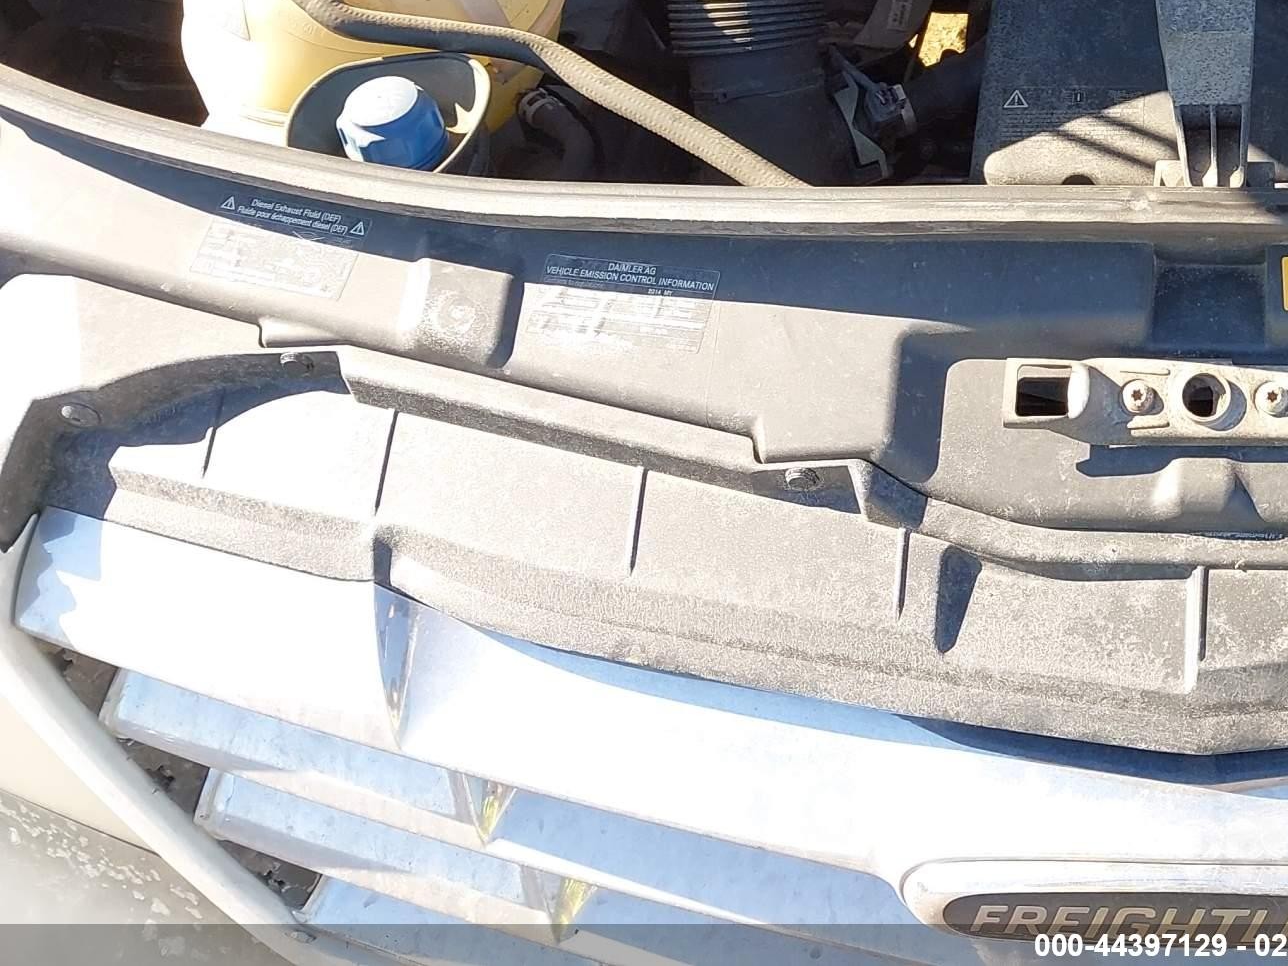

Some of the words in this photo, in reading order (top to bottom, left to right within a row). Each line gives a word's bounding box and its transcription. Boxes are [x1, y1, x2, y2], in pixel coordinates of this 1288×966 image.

[251, 198, 275, 210] Diesel
[274, 202, 303, 215] Exhaust
[302, 208, 321, 219] Fluid
[320, 212, 342, 224] (DEF)
[546, 264, 579, 276] VEHICLE
[580, 269, 619, 281] EMISSION
[619, 273, 656, 286] CONTROL
[656, 276, 714, 291] INFORMATION
[608, 262, 643, 274] DAIMLER
[643, 265, 657, 275] AG
